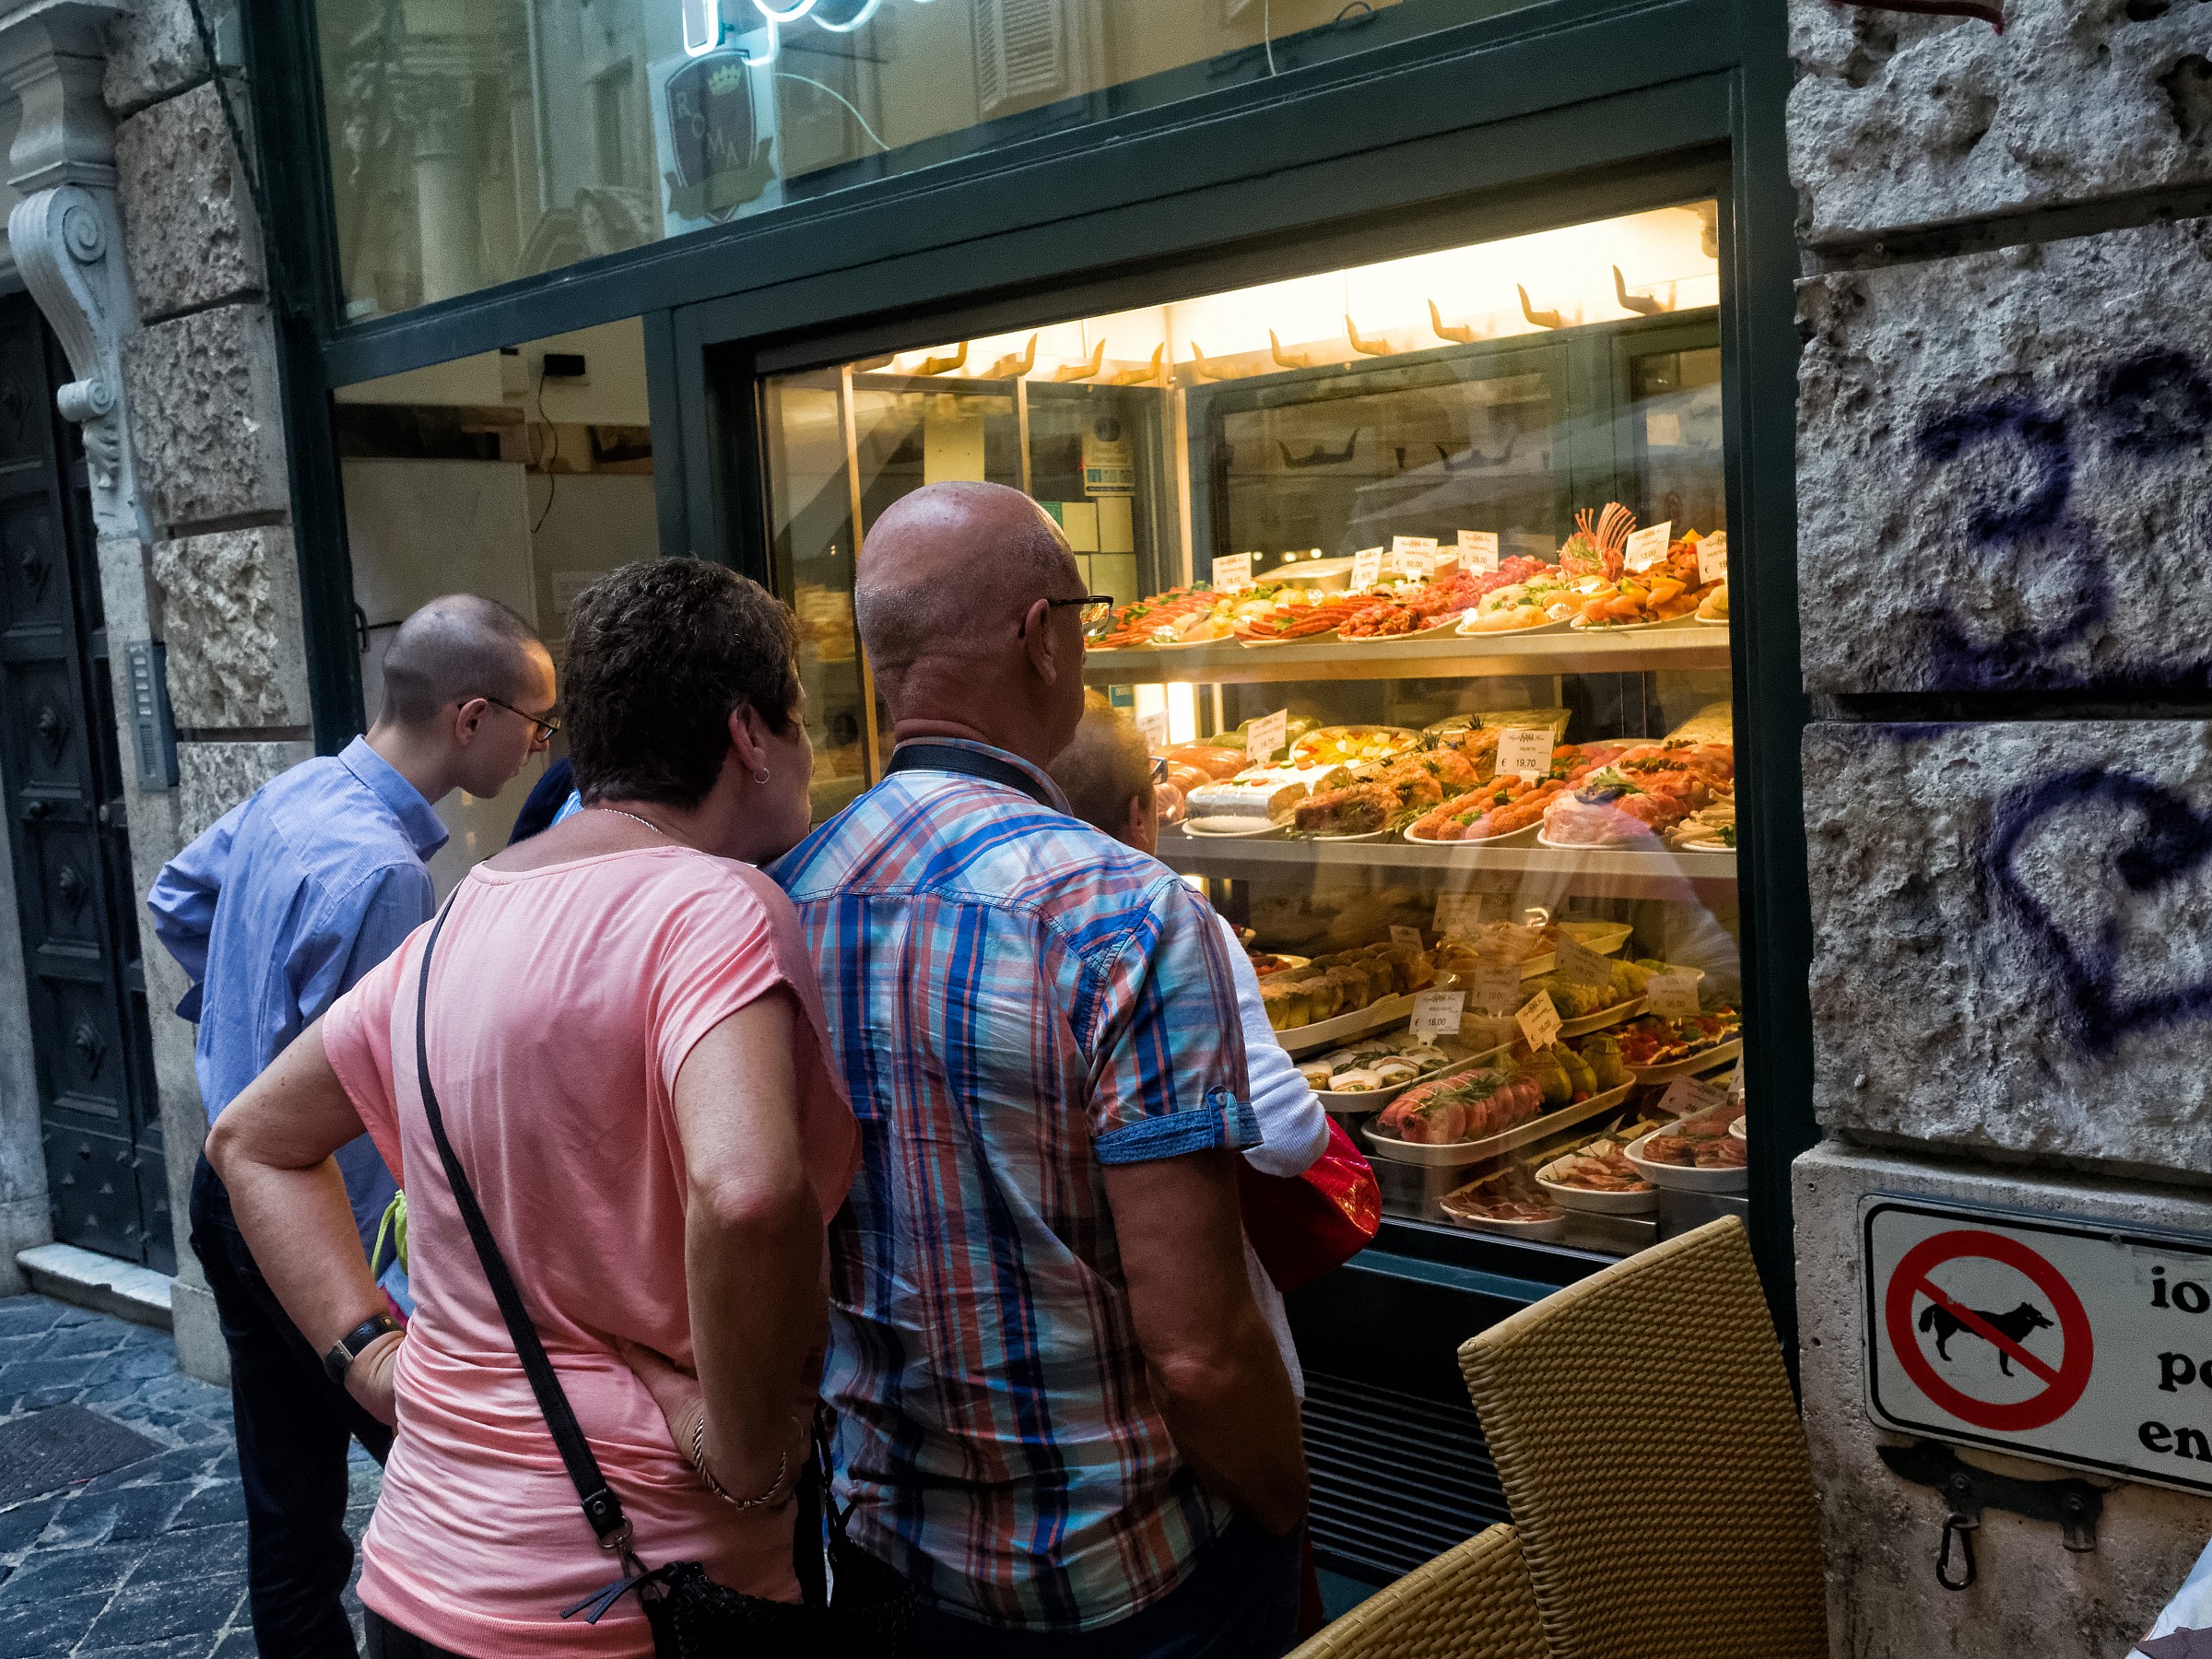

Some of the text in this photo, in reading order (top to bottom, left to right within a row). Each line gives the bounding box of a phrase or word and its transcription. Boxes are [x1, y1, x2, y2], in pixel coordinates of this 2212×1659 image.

[676, 90, 740, 169] ROMA
[1516, 759, 1536, 768] 19,70
[2150, 1265, 2210, 1314] io
